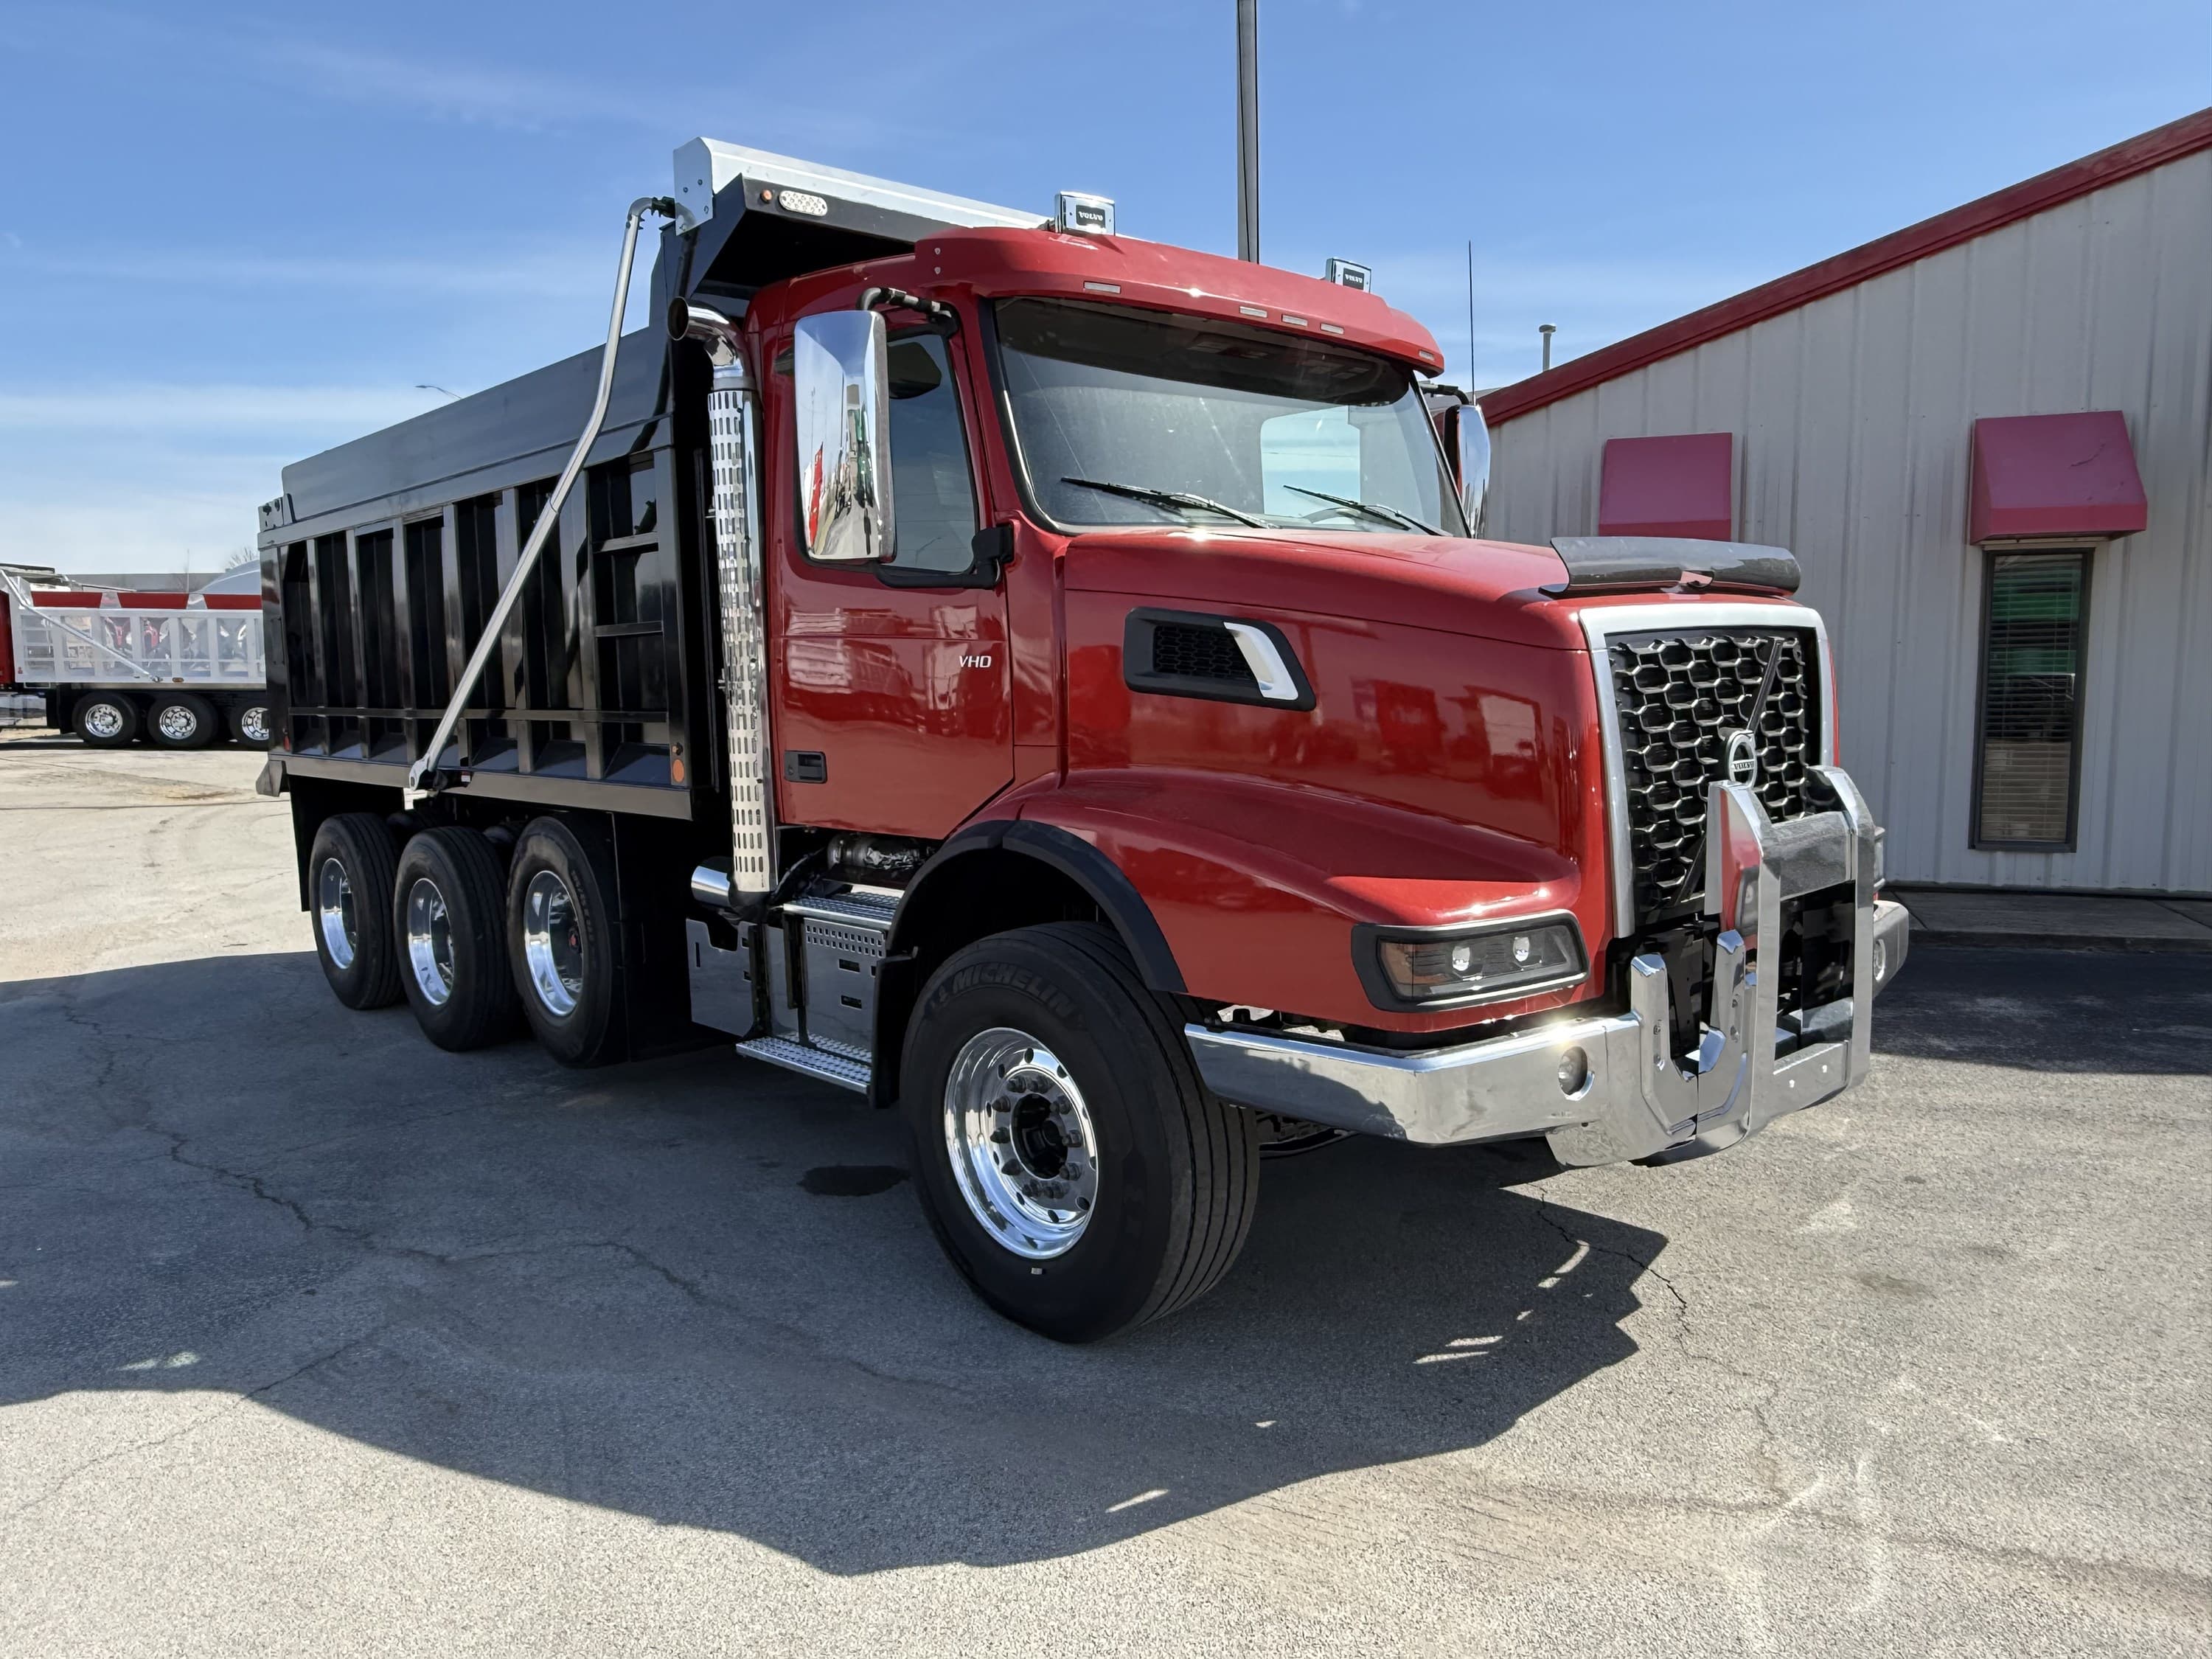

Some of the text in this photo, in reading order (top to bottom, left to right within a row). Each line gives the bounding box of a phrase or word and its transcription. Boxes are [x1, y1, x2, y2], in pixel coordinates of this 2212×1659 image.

[1078, 211, 1104, 221] VOLVO
[959, 655, 992, 668] VHD
[952, 961, 1076, 1018] MICHELIN
